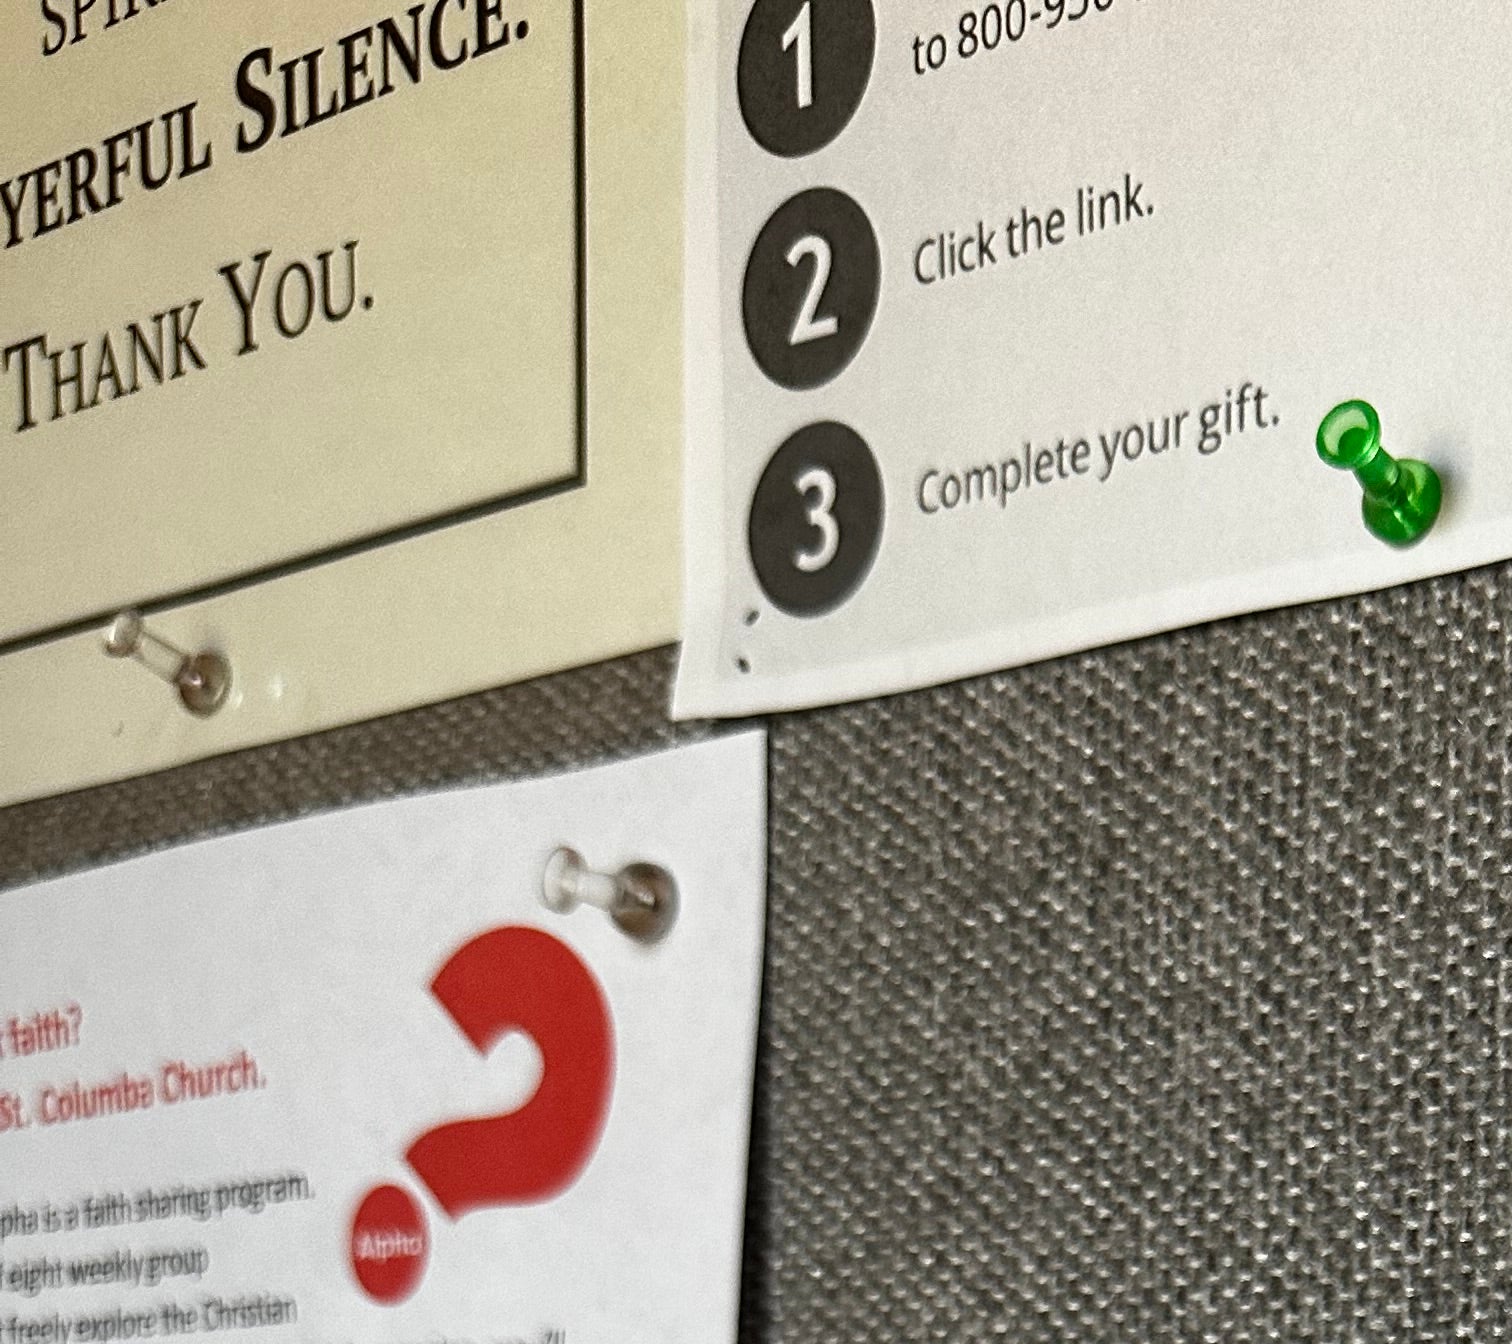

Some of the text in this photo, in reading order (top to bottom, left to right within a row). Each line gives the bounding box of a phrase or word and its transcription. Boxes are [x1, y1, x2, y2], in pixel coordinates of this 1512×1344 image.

[781, 8, 814, 109] 1
[912, 34, 948, 76] to
[913, 173, 1155, 285] Click the link.
[4, 240, 374, 433] THANK YOU.
[785, 235, 838, 345] 2
[917, 382, 1280, 514] Complete your gift.
[794, 468, 840, 572] 3
[8, 1001, 83, 1057] faith?
[39, 1050, 266, 1125] Columba Church.
[8, 1248, 209, 1297] eight weekly group
[160, 1302, 199, 1335] the
[201, 1295, 297, 1331] Christian
